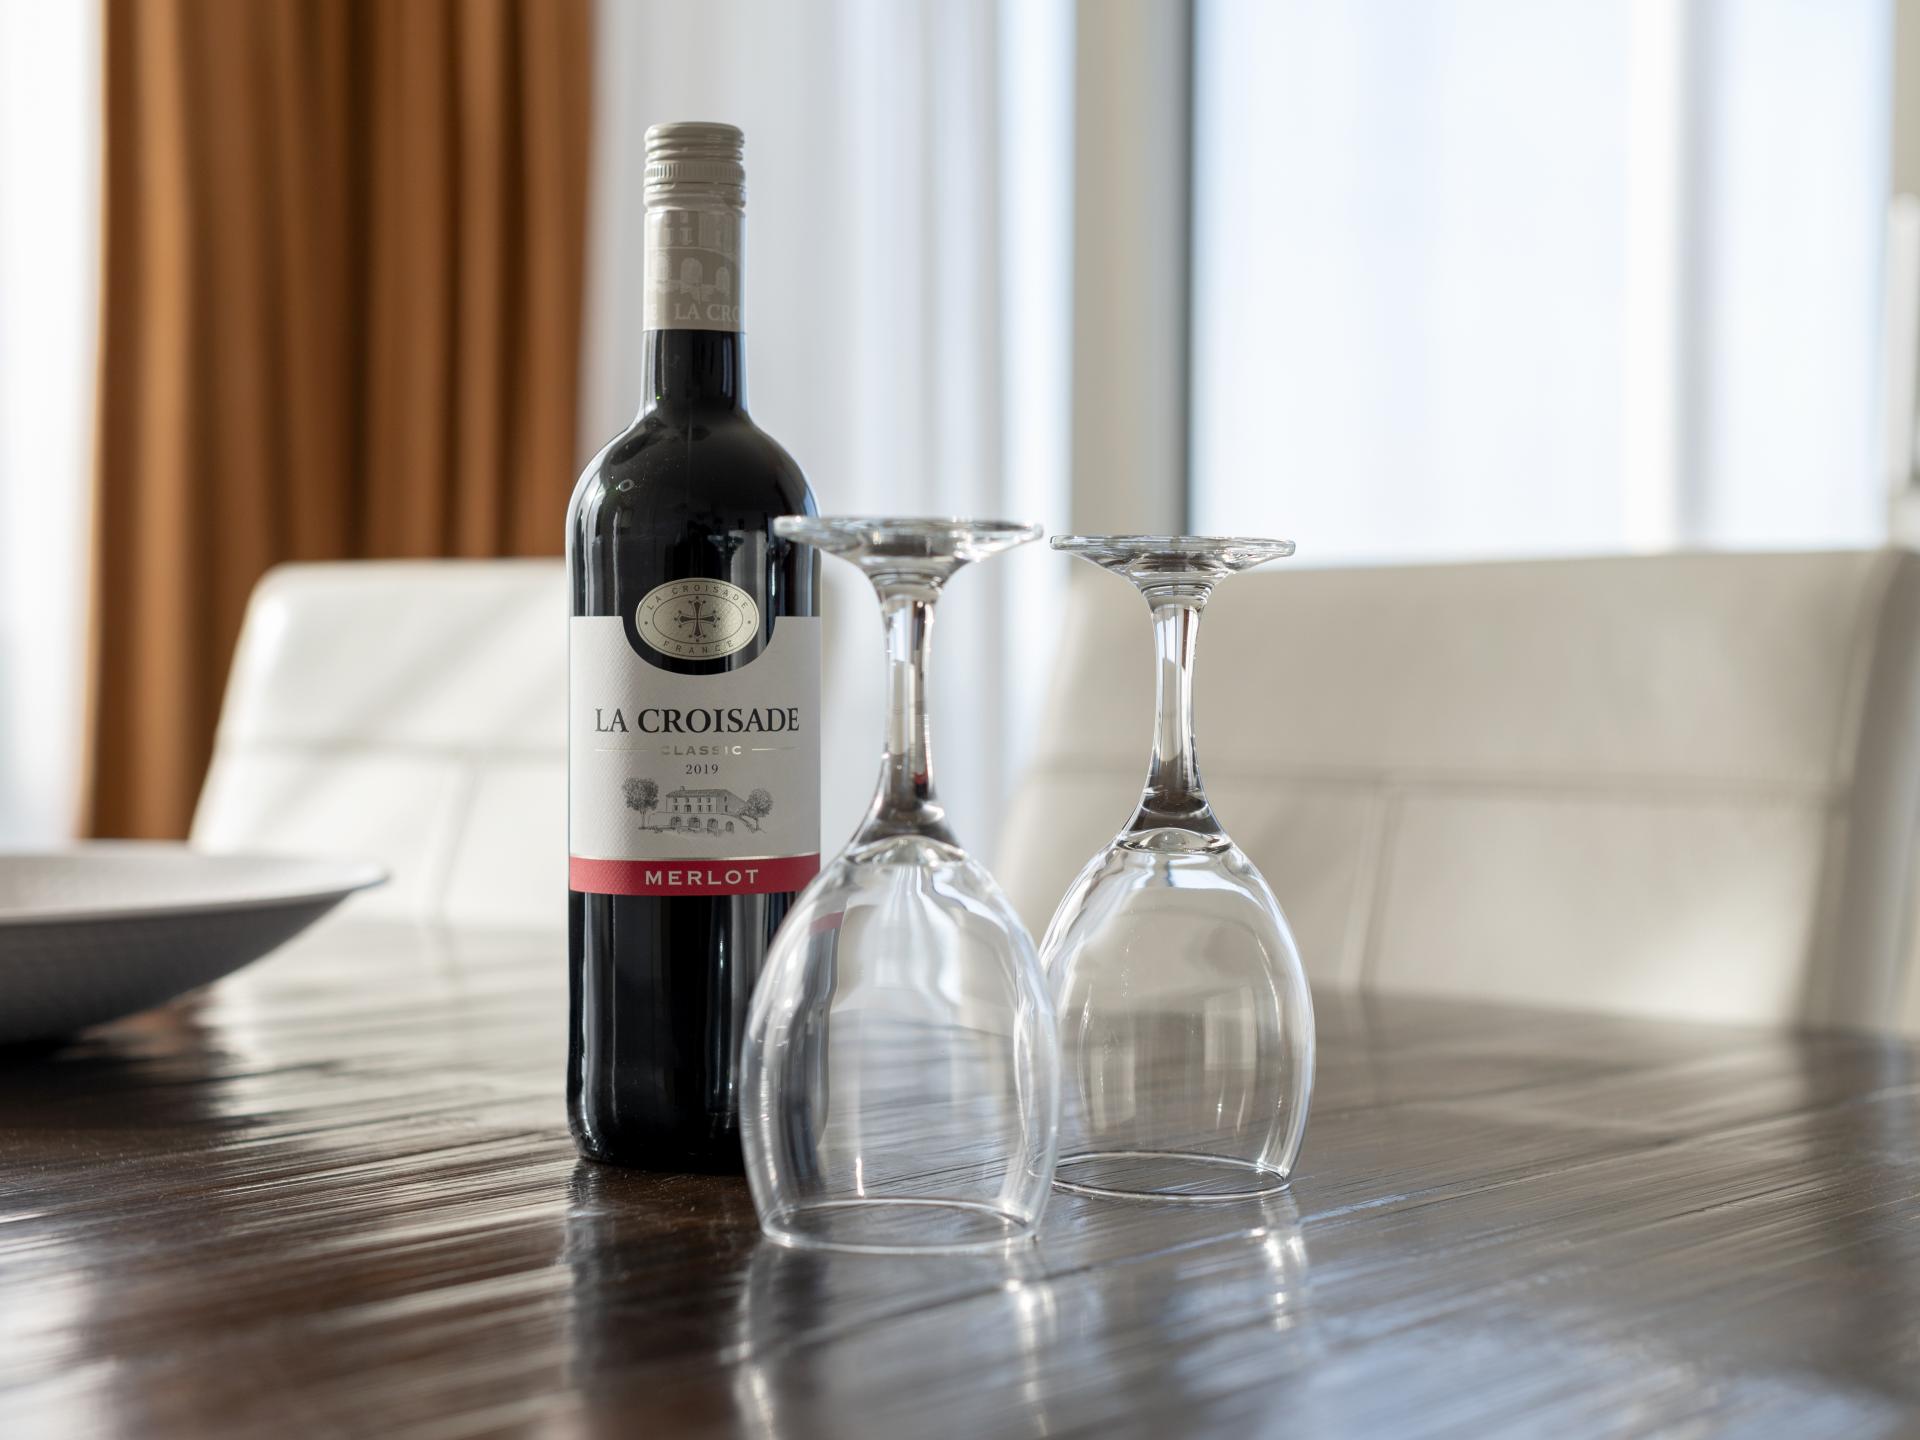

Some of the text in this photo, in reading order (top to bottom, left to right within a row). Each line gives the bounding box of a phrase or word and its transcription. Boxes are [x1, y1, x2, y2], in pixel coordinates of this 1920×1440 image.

[674, 303, 700, 320] LA
[647, 584, 748, 610] LA CROISADE
[663, 640, 733, 655] FRANCE
[595, 708, 799, 733] LA CROISADE
[661, 746, 742, 756] CLASSIC
[685, 764, 719, 775] 2019
[645, 869, 759, 886] MERLOT
